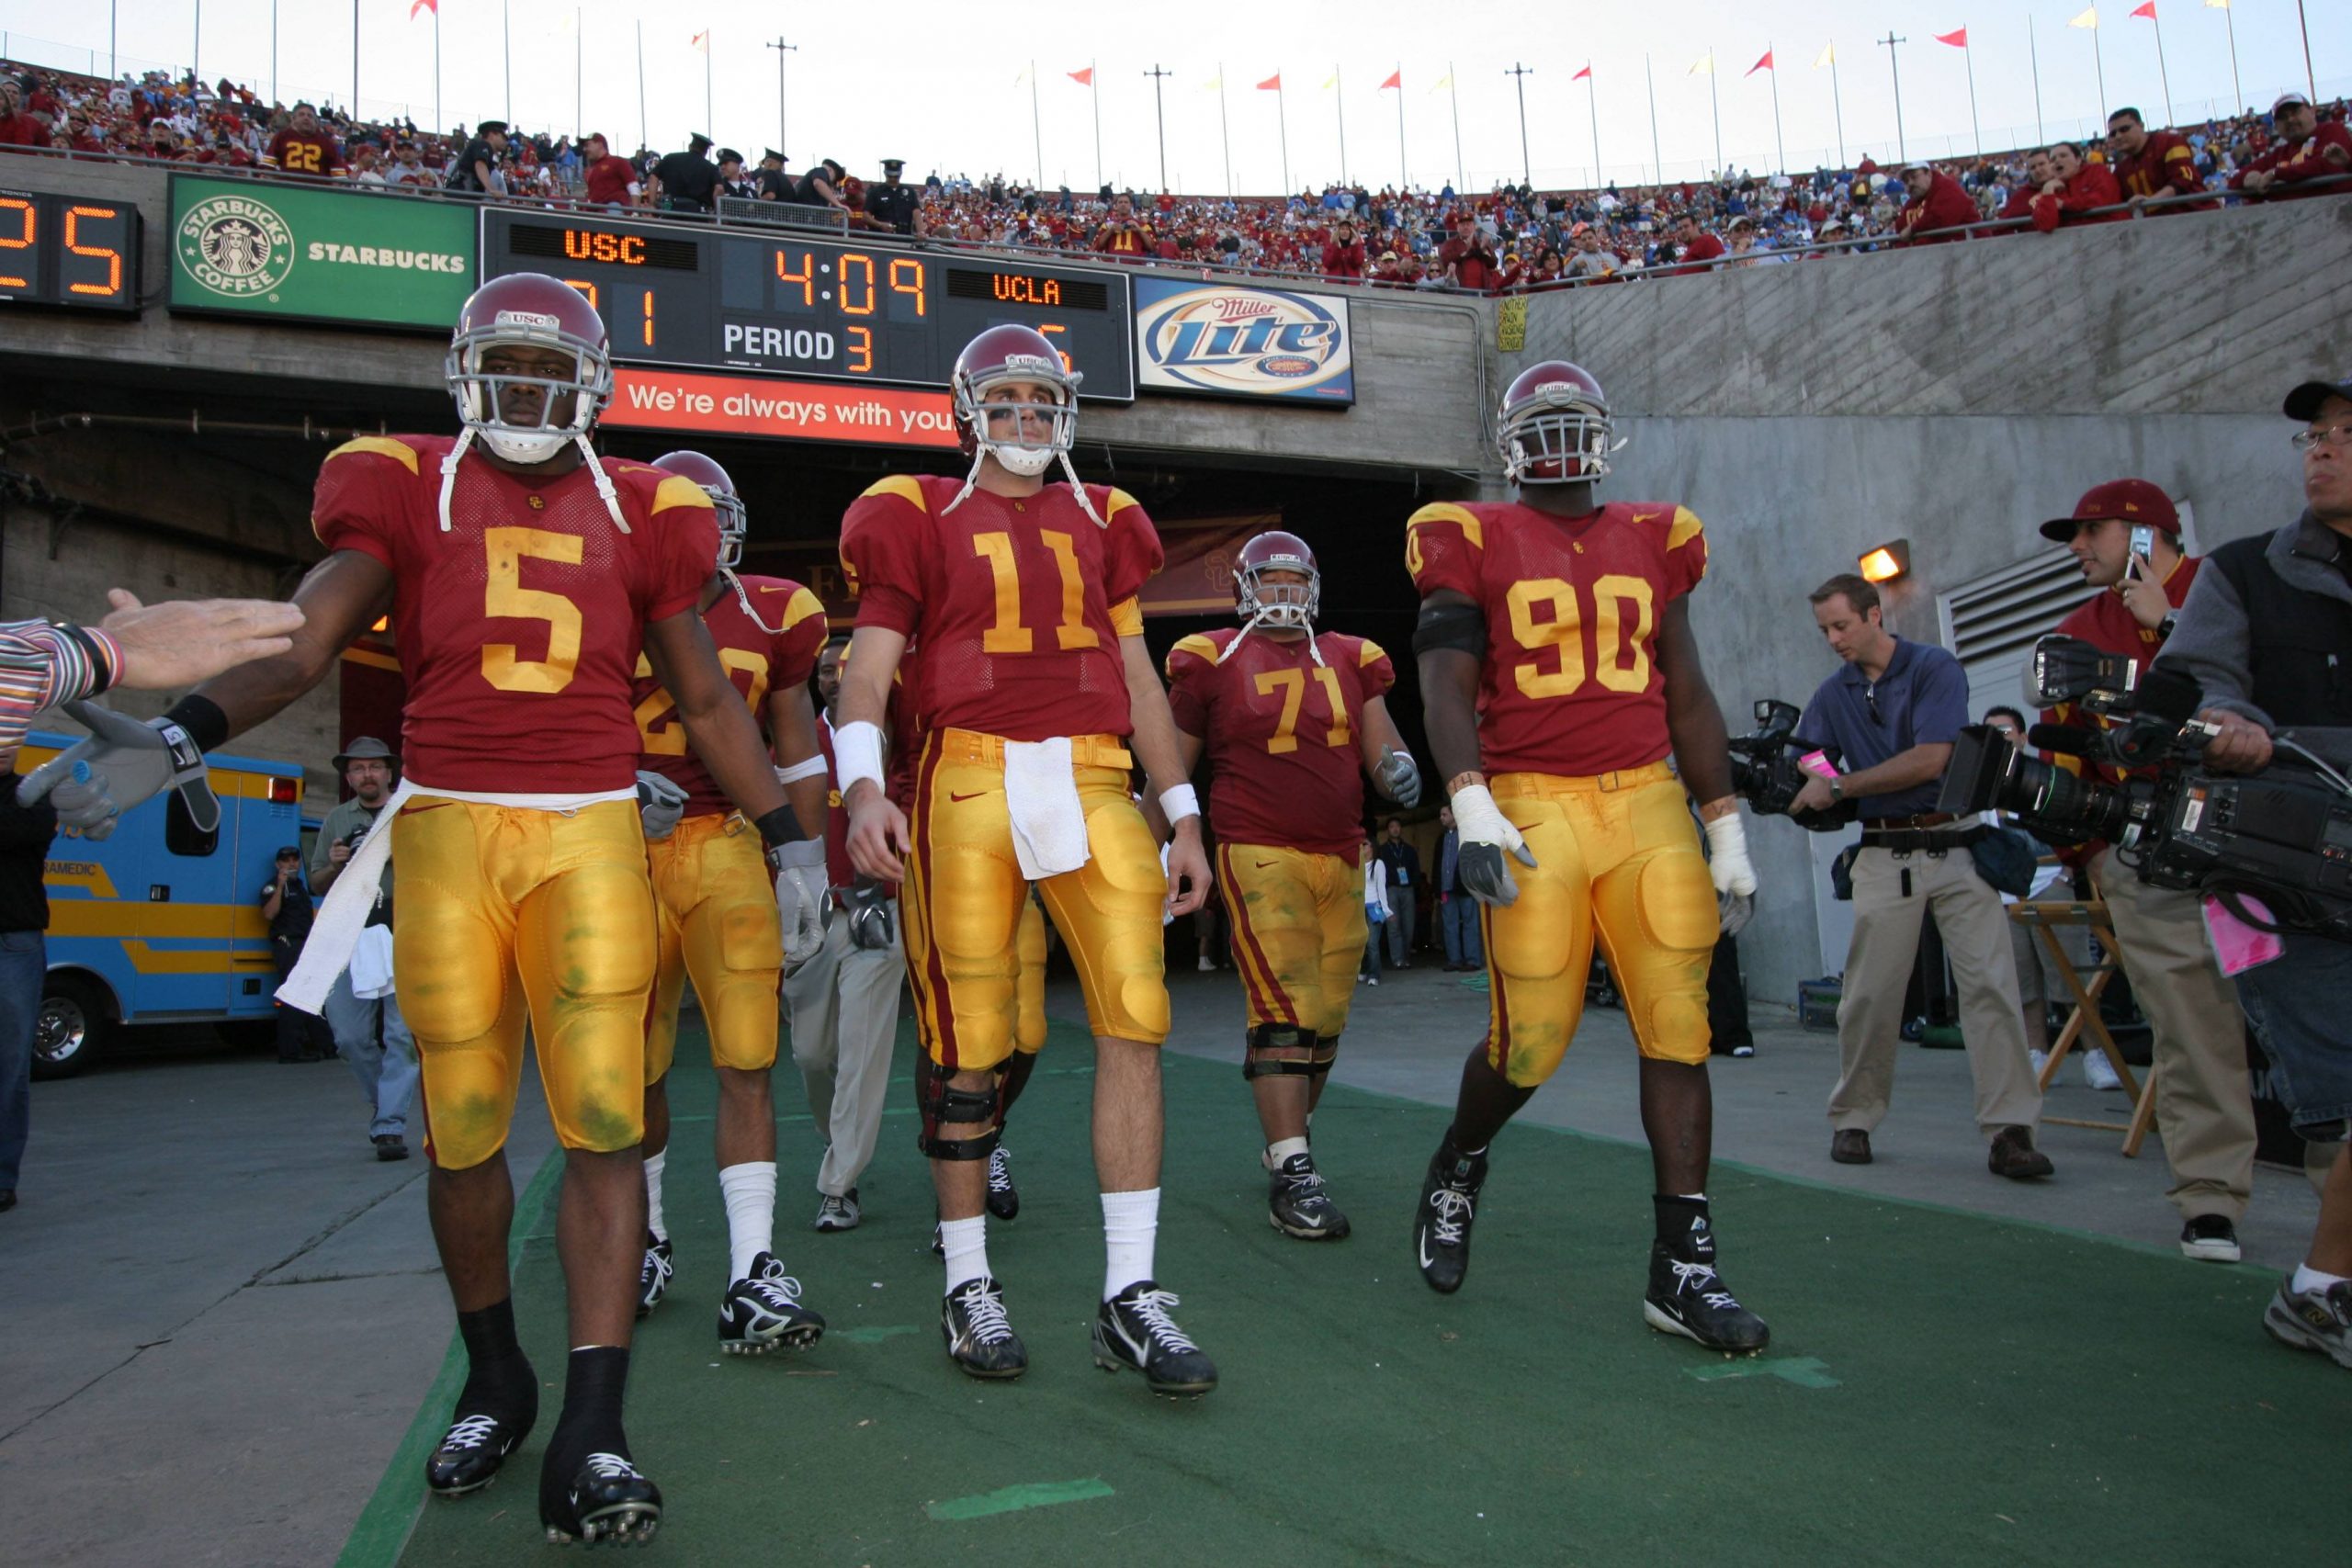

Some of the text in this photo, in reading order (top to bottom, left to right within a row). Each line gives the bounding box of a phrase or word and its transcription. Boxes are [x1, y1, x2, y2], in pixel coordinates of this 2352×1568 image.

[286, 141, 322, 173] 22
[183, 199, 288, 246] STARBUCKS
[1114, 230, 1134, 252] 11
[309, 243, 465, 274] STARBUCKS
[565, 230, 645, 265] USC
[194, 264, 275, 293] COFFEE
[776, 250, 925, 317] 4:09
[994, 275, 1059, 306] UCLA
[512, 313, 545, 325] USC
[1211, 297, 1278, 319] Miller
[724, 324, 834, 360] PERIOD
[847, 325, 872, 372] 3
[1158, 317, 1336, 367] Lite
[628, 384, 715, 413] We're
[723, 393, 827, 426] always
[834, 400, 891, 427] with
[972, 527, 1100, 653] 11
[481, 526, 584, 694] 5
[1506, 574, 1653, 700] 90
[1253, 667, 1351, 755] 71
